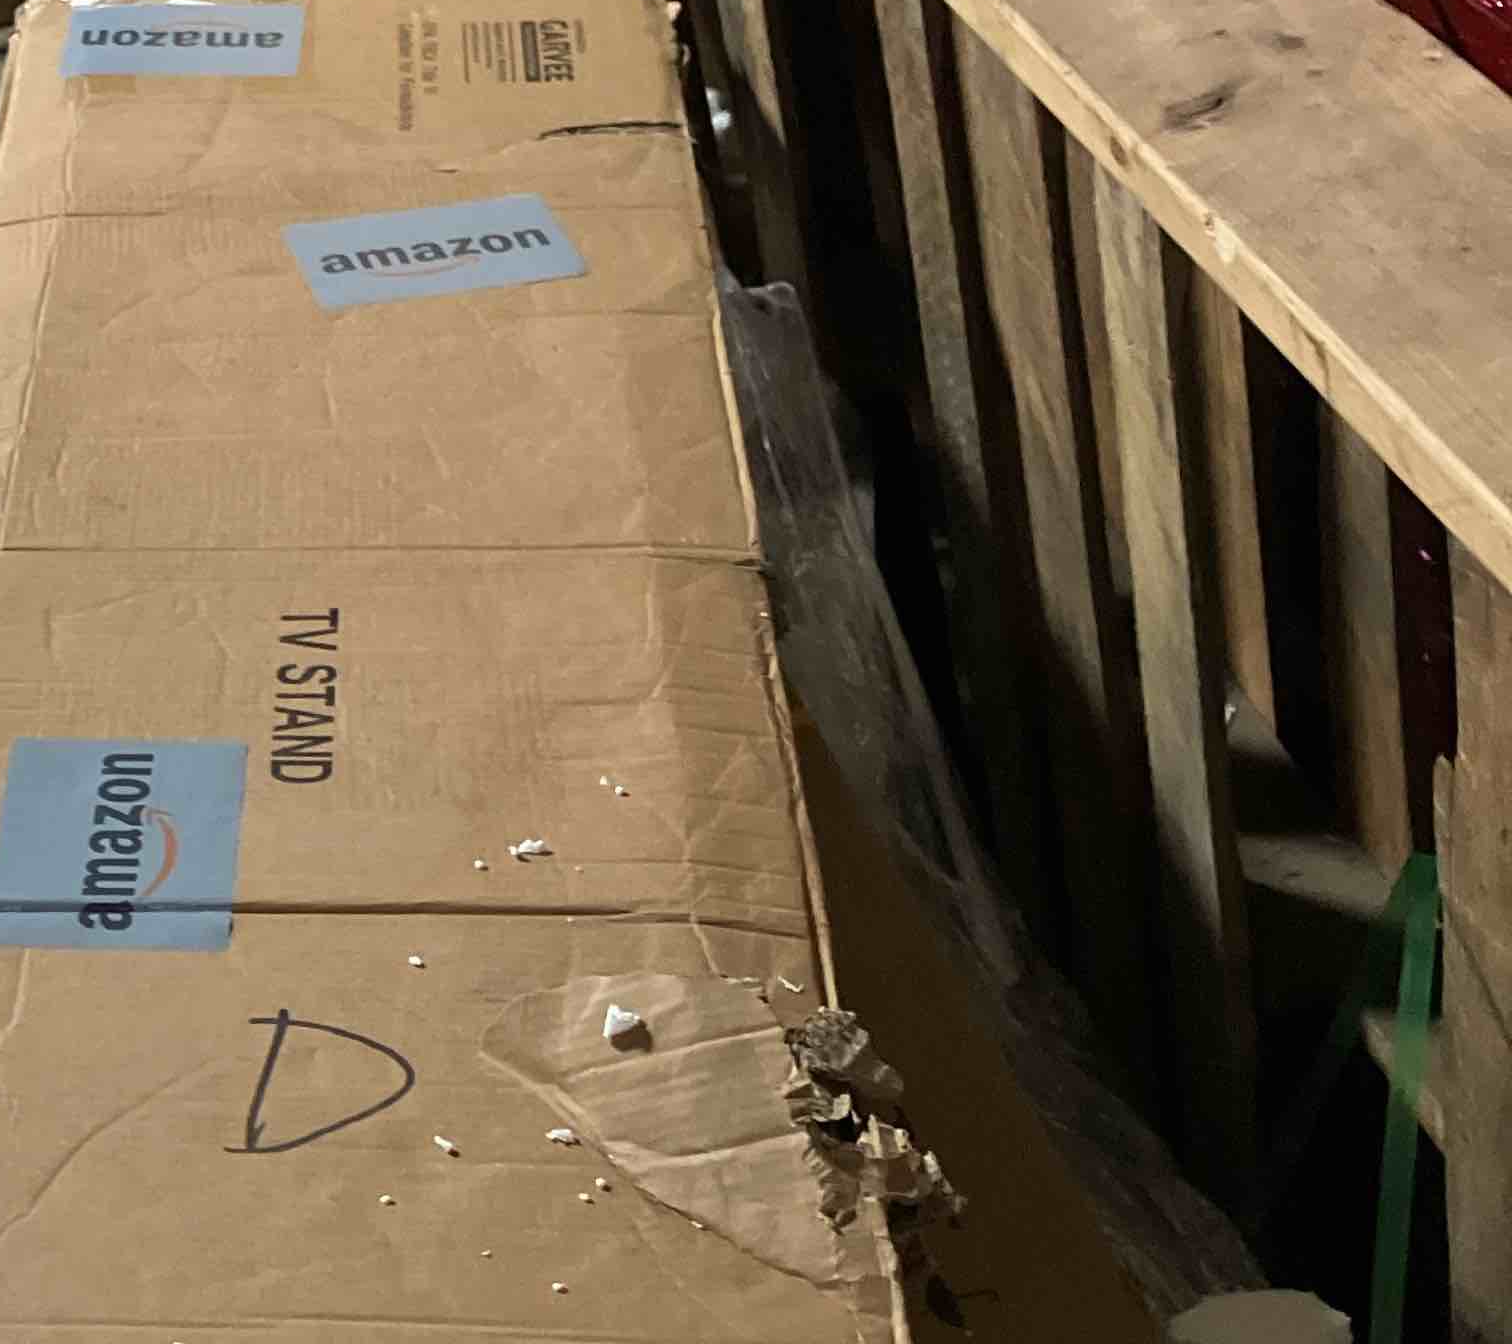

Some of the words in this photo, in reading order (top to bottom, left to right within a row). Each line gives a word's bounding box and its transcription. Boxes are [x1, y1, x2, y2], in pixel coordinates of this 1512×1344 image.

[80, 27, 285, 51] amazon
[320, 224, 552, 278] amazon
[279, 607, 340, 653] TV
[270, 663, 338, 786] STAND
[78, 751, 155, 933] amazon
